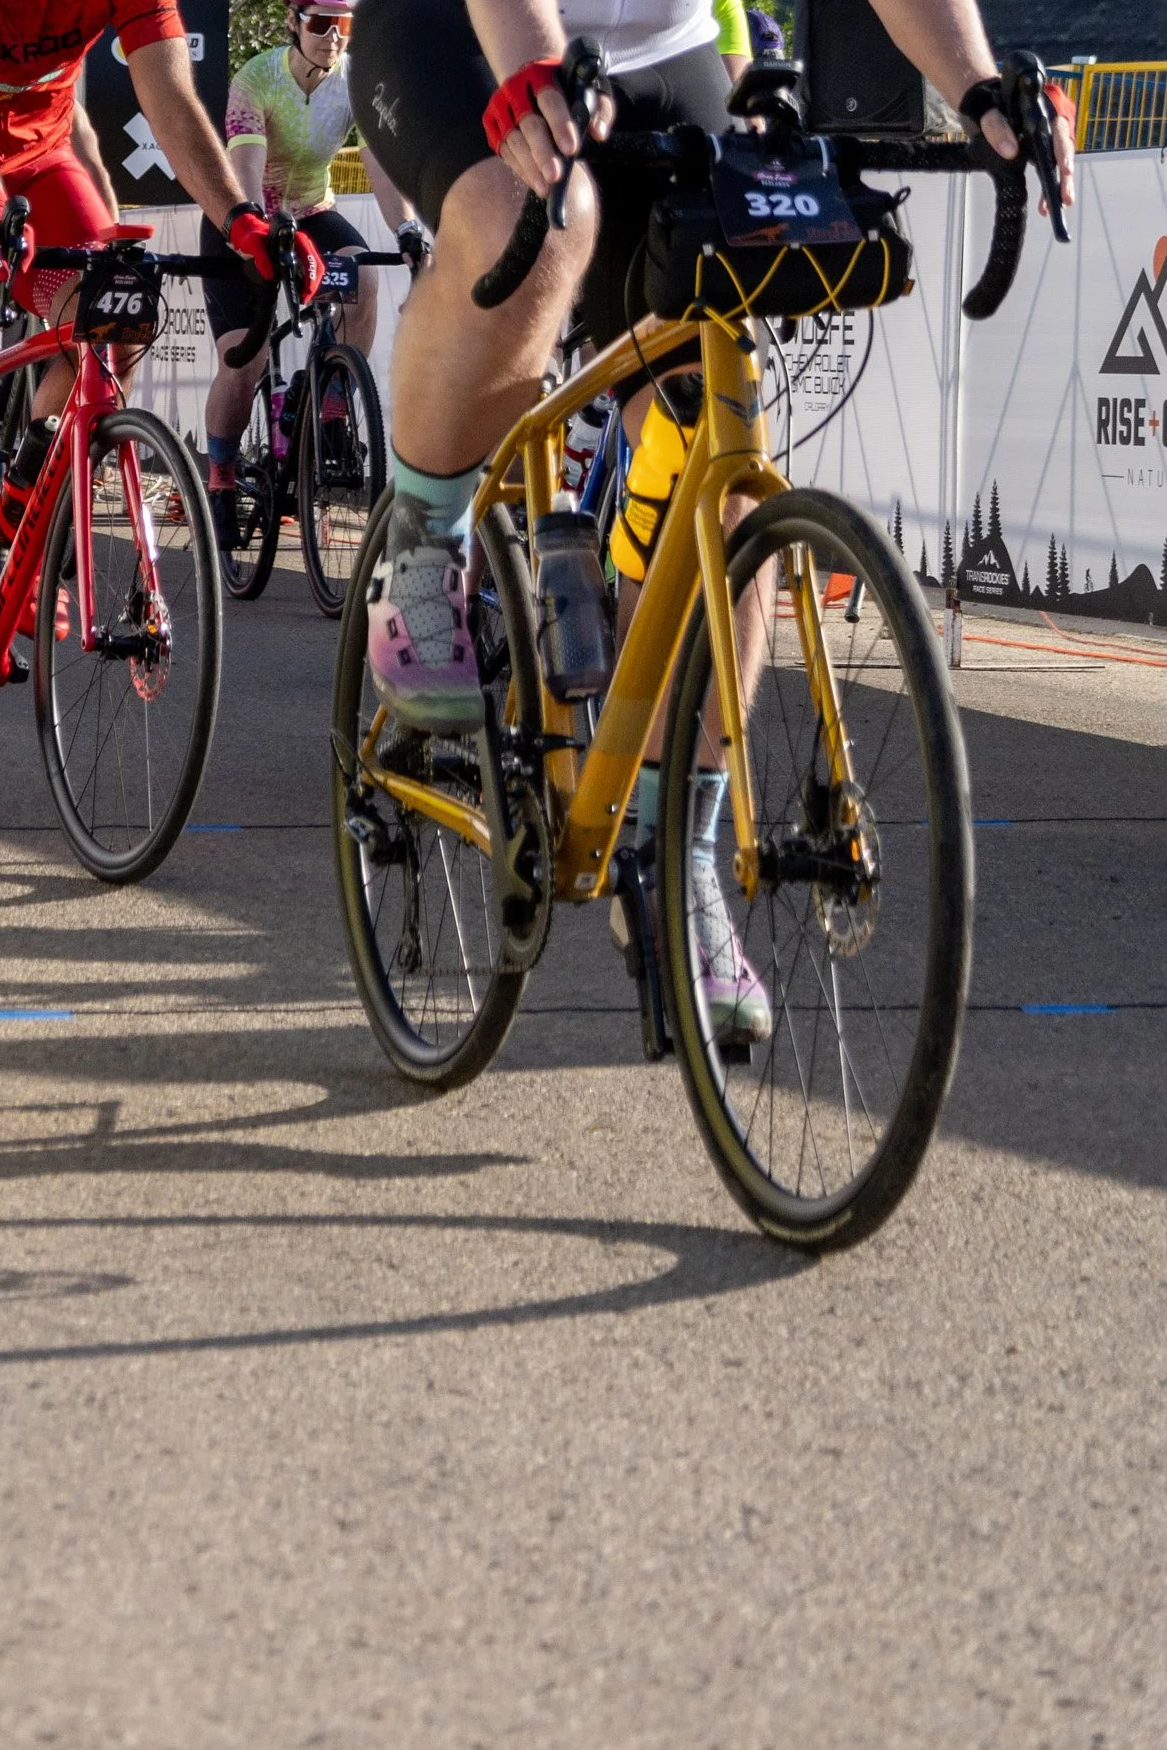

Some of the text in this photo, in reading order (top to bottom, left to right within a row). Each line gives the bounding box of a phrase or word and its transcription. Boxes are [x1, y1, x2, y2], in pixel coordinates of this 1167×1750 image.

[744, 192, 820, 216] 320
[322, 272, 349, 286] 325
[97, 291, 143, 315] 476
[164, 308, 205, 335] ROCKIES
[151, 346, 196, 362] RACE SERIES
[814, 376, 846, 396] BUICK
[1096, 397, 1167, 447] RISE+
[1127, 468, 1164, 487] NATU
[965, 569, 1010, 586] TRANSROCKIES
[972, 585, 1003, 595] RACE SERIES
